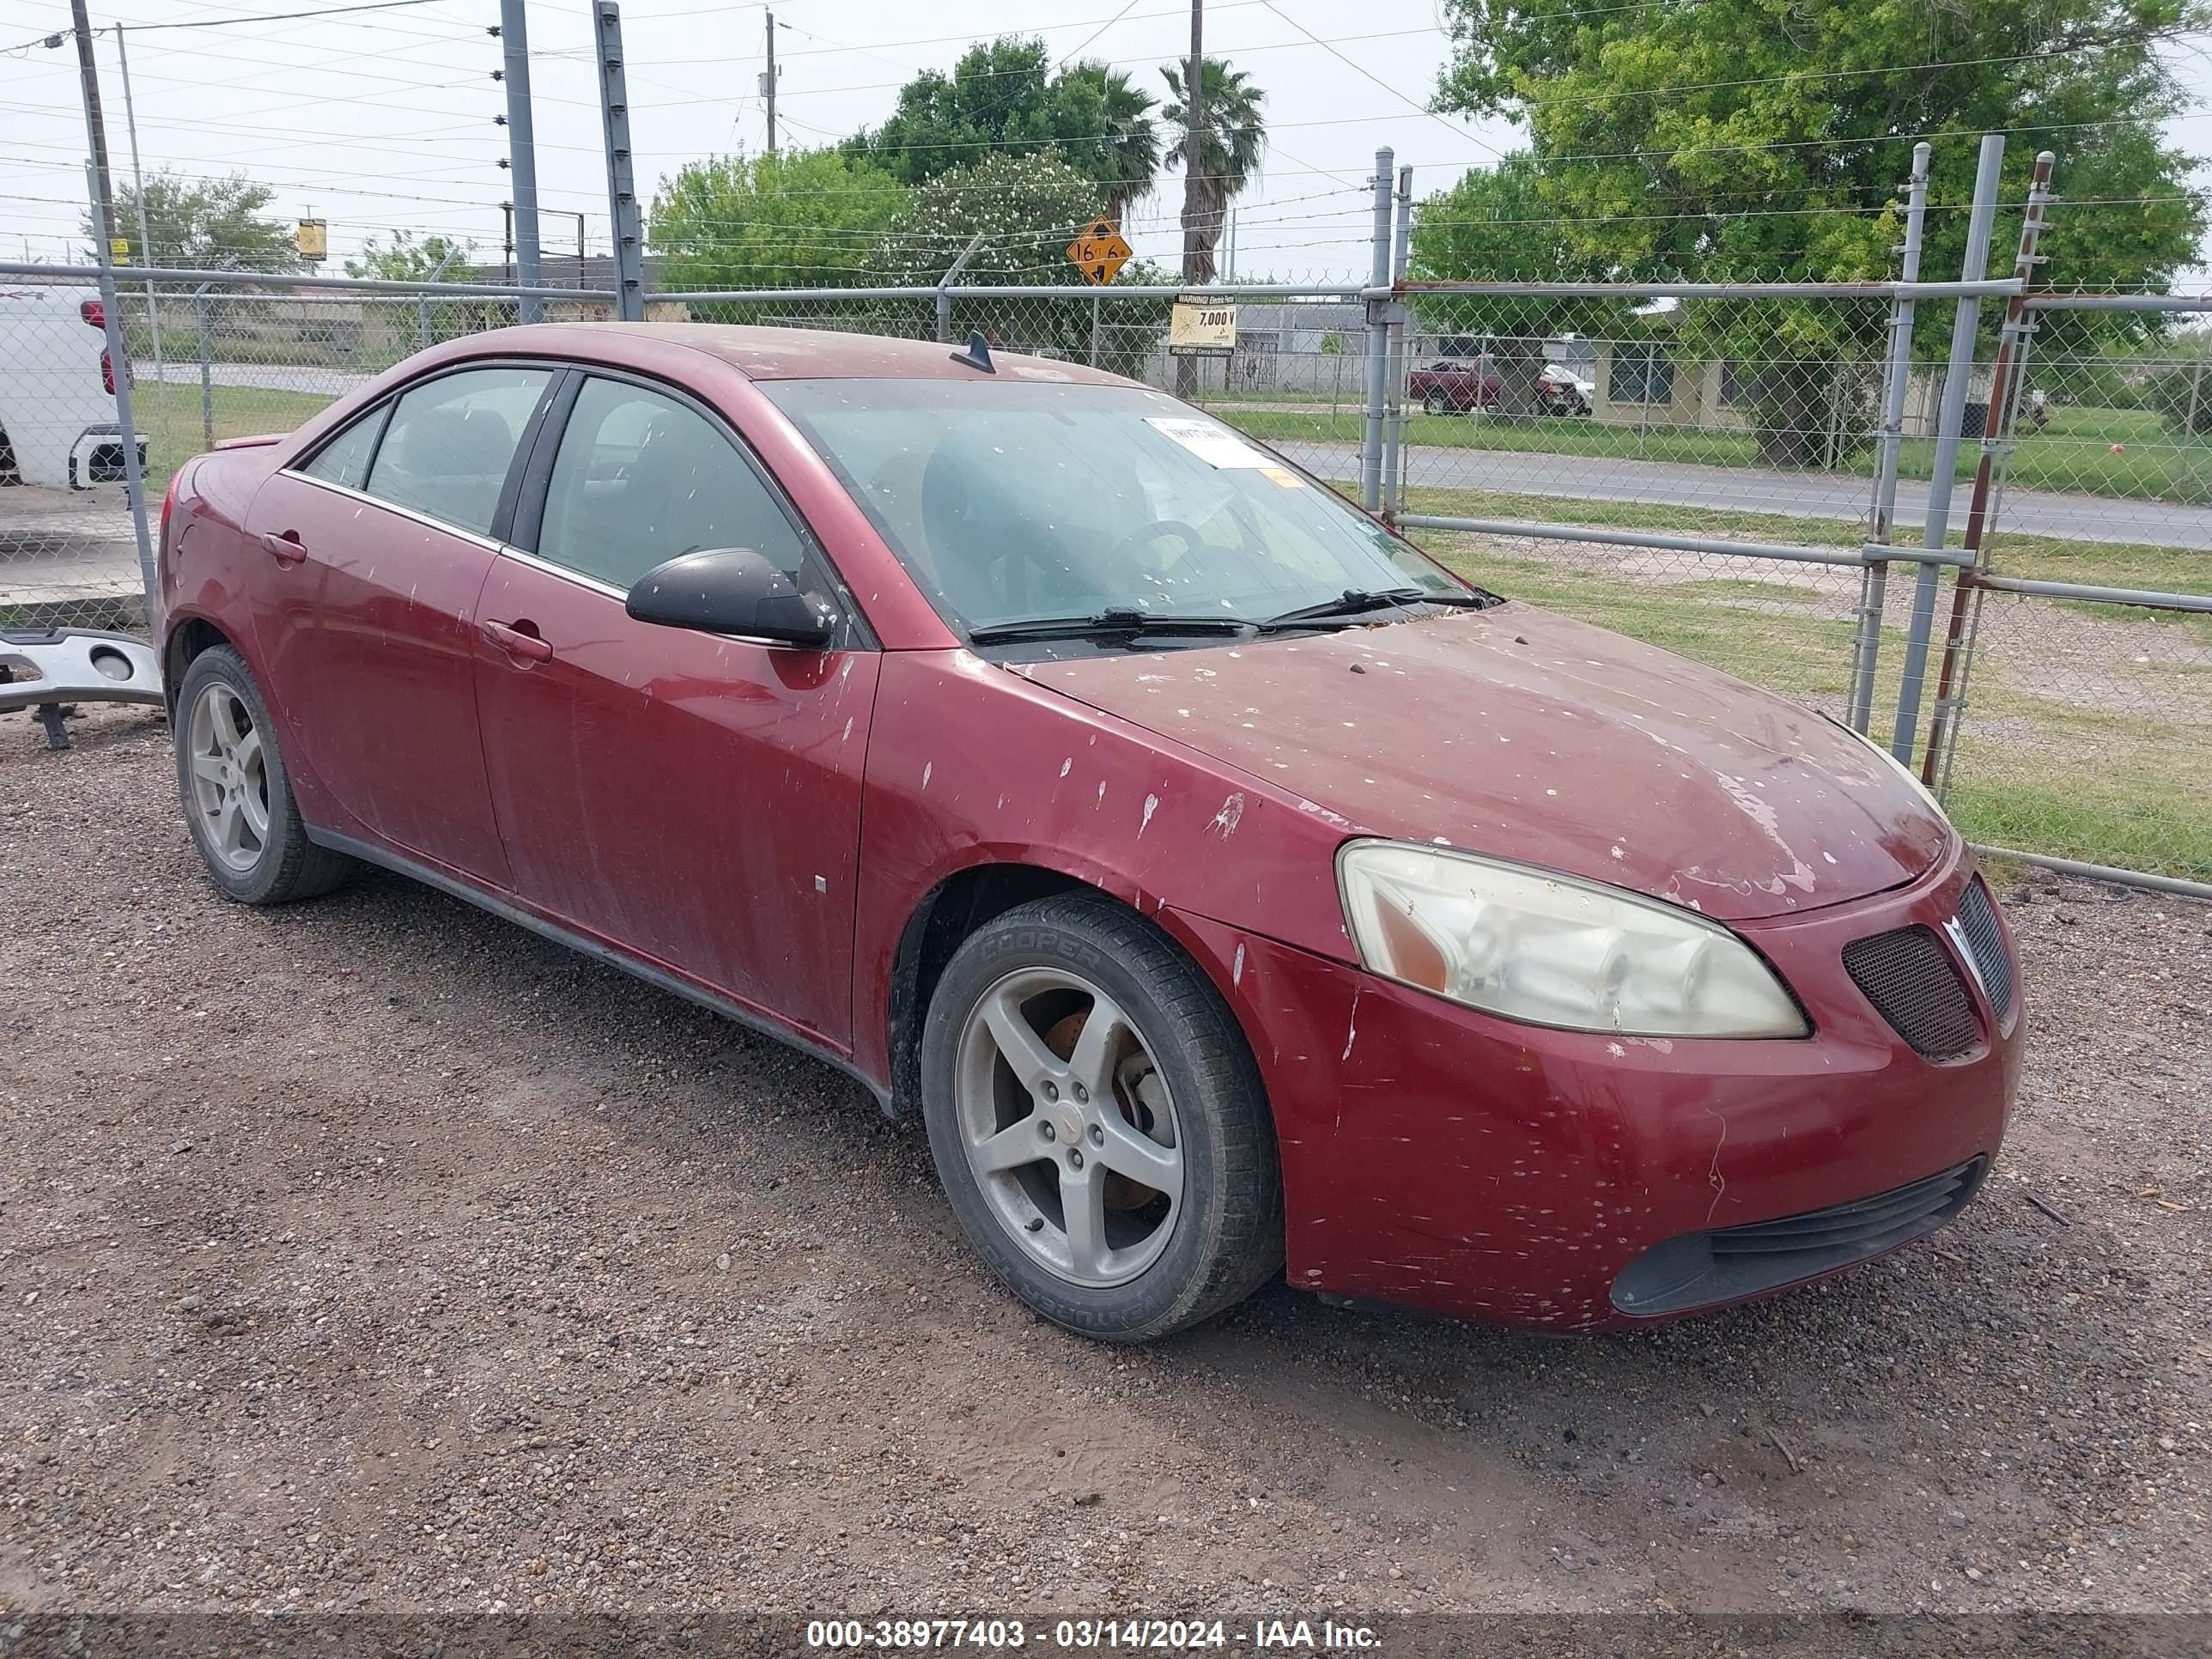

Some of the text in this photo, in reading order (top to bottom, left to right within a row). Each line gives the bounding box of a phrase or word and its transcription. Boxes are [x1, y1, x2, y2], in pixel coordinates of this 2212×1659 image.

[1077, 243, 1094, 261] 16
[1108, 245, 1118, 259] 6
[1178, 295, 1209, 304] WARNING!
[1200, 312, 1235, 327] 7,000 V
[980, 931, 1101, 971] COOPER
